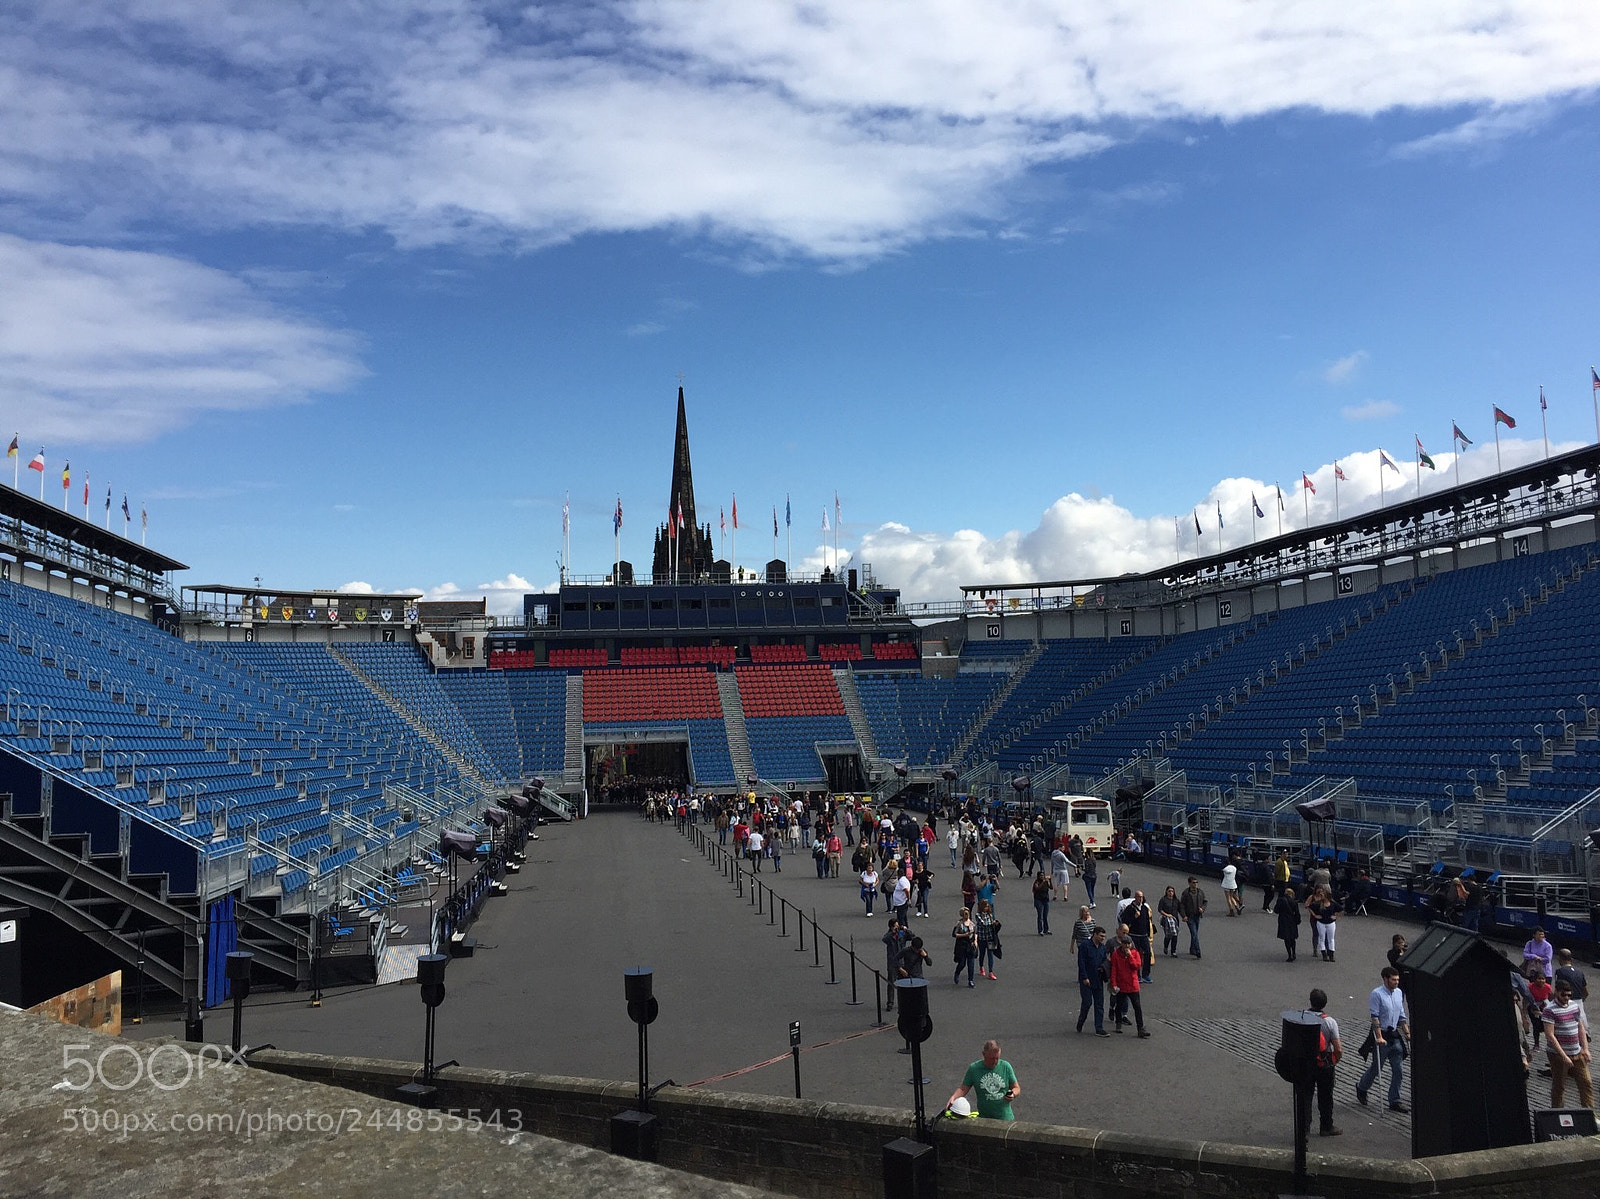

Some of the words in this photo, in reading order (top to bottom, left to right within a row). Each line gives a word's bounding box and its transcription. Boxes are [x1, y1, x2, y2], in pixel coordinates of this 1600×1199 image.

[1514, 540, 1528, 556] 14
[3, 564, 9, 580] 4
[1339, 576, 1352, 590] 13
[1220, 603, 1231, 616] 12
[988, 626, 999, 636] 10
[1121, 622, 1130, 633] 11
[246, 630, 252, 642] 6
[385, 631, 392, 641] 7
